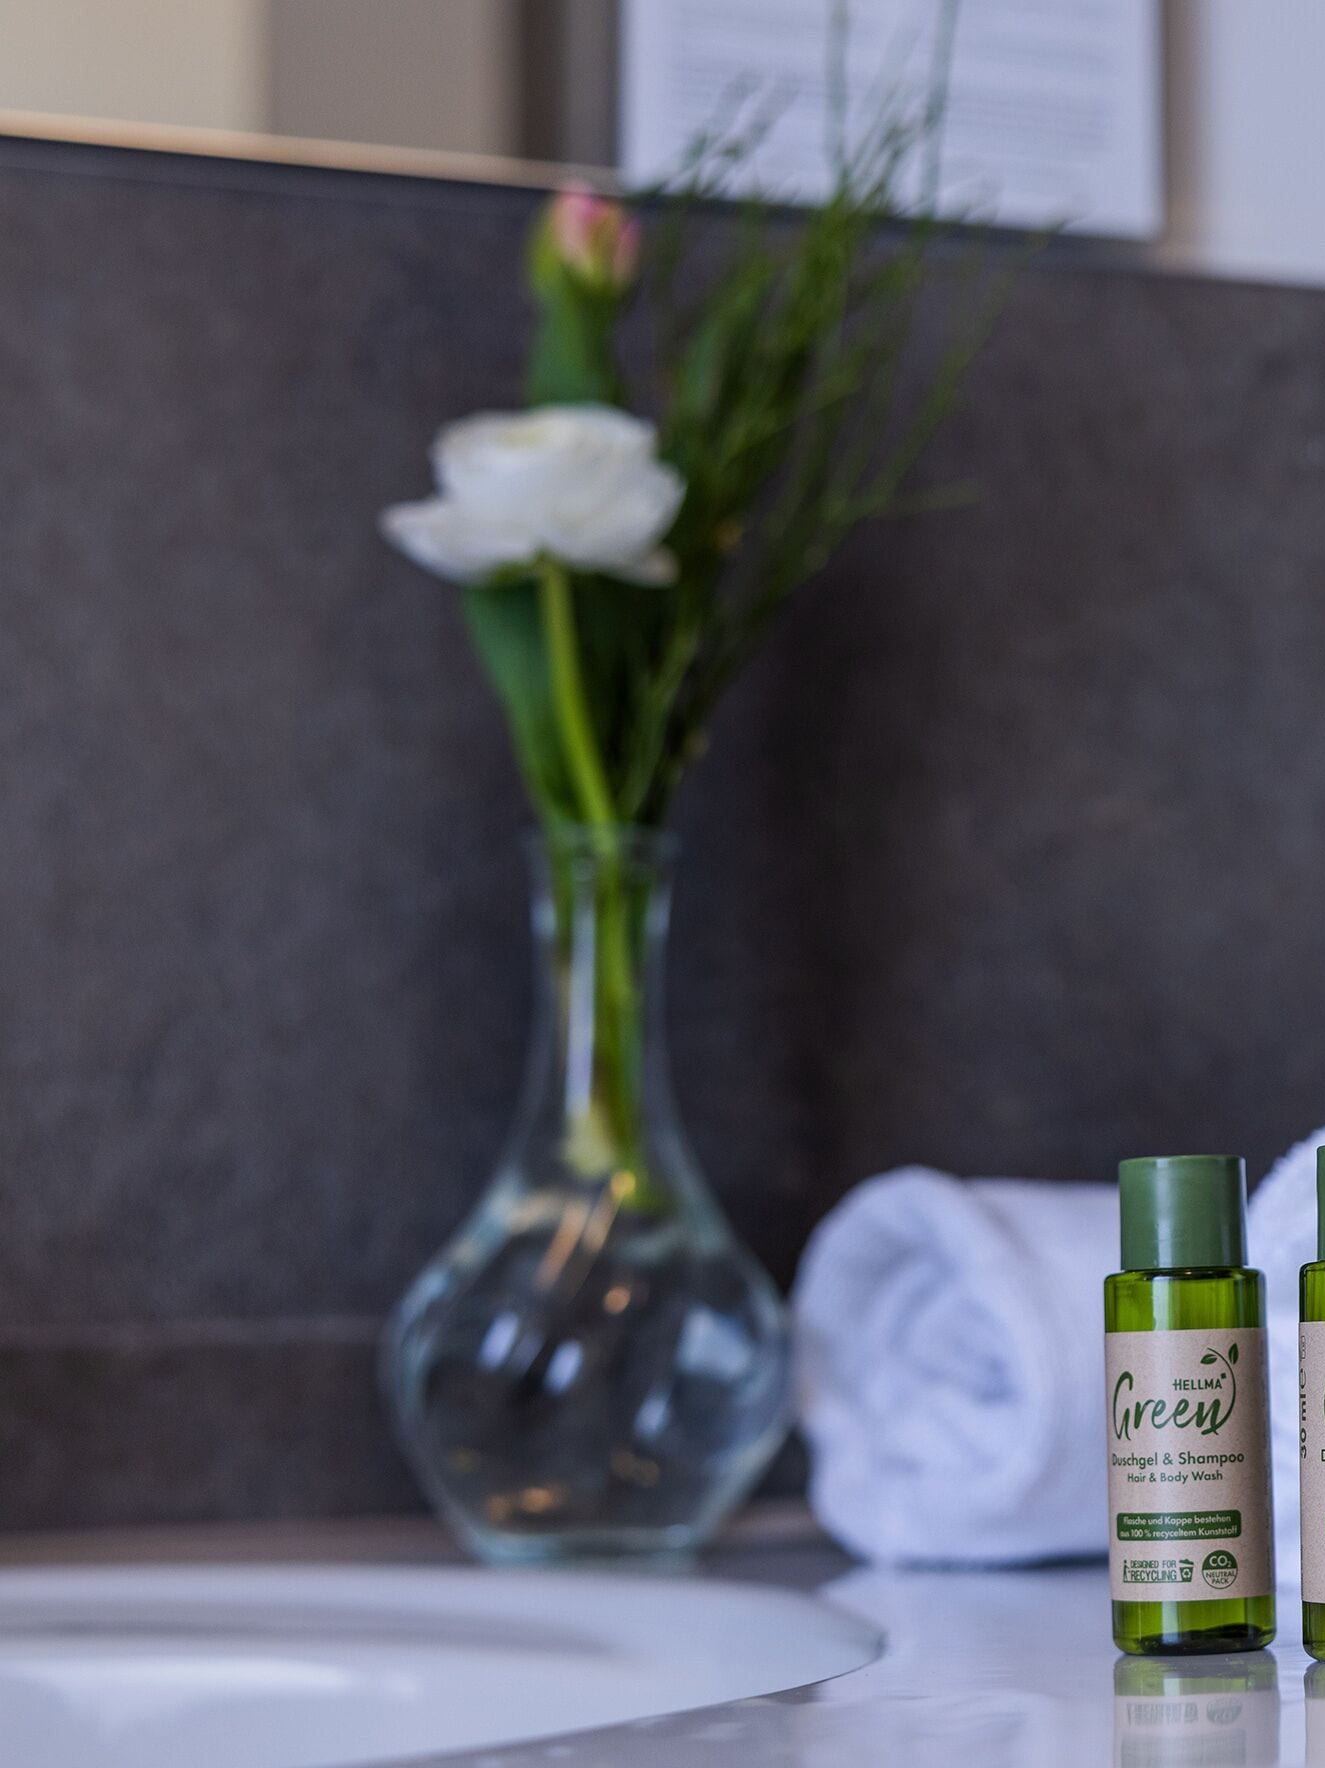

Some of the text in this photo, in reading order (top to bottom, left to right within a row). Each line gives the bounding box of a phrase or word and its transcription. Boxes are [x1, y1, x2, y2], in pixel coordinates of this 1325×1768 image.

[1172, 1378, 1223, 1391] HELLMA
[1113, 1371, 1235, 1441] Green
[1112, 1451, 1245, 1469] Duschgel & Shampoo
[1127, 1470, 1223, 1484] Hair & Body Wash
[1123, 1514, 1232, 1526] Flasche und Kappe bestehen
[1131, 1528, 1143, 1538] 100
[1144, 1529, 1152, 1538] %
[1153, 1528, 1197, 1539] recyceltem
[1198, 1525, 1238, 1536] Kunststoff
[1130, 1559, 1177, 1569] DESIGNED FOR
[1130, 1570, 1177, 1581] RECYCLING
[1205, 1570, 1236, 1578] NEUTRAL
[1211, 1577, 1229, 1585] PACK
